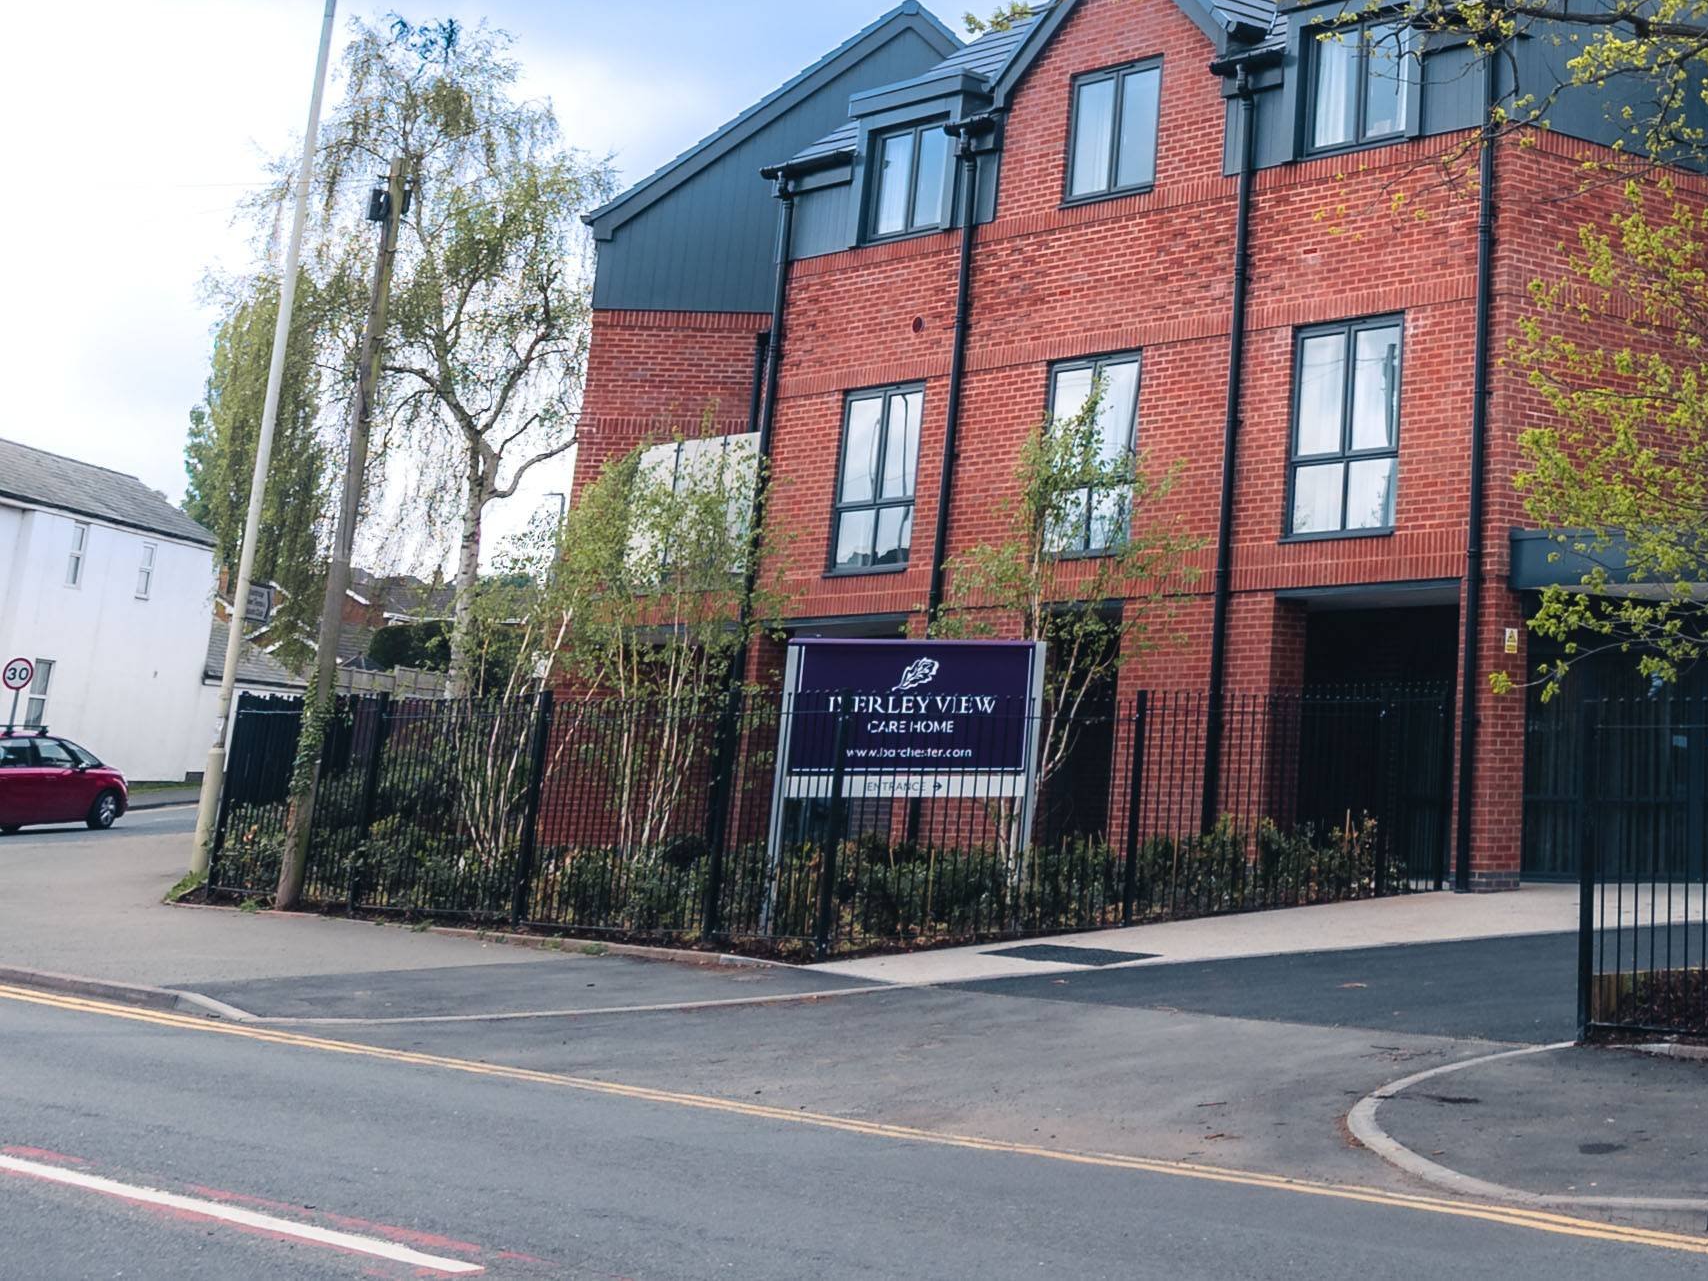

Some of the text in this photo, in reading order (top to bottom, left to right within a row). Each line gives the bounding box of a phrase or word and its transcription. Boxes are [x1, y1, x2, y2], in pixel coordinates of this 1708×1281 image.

[7, 667, 29, 681] 30
[829, 696, 996, 714] IERLEY VIEW
[867, 720, 955, 734] CARE HOME
[866, 781, 926, 792] ENTRANCE
